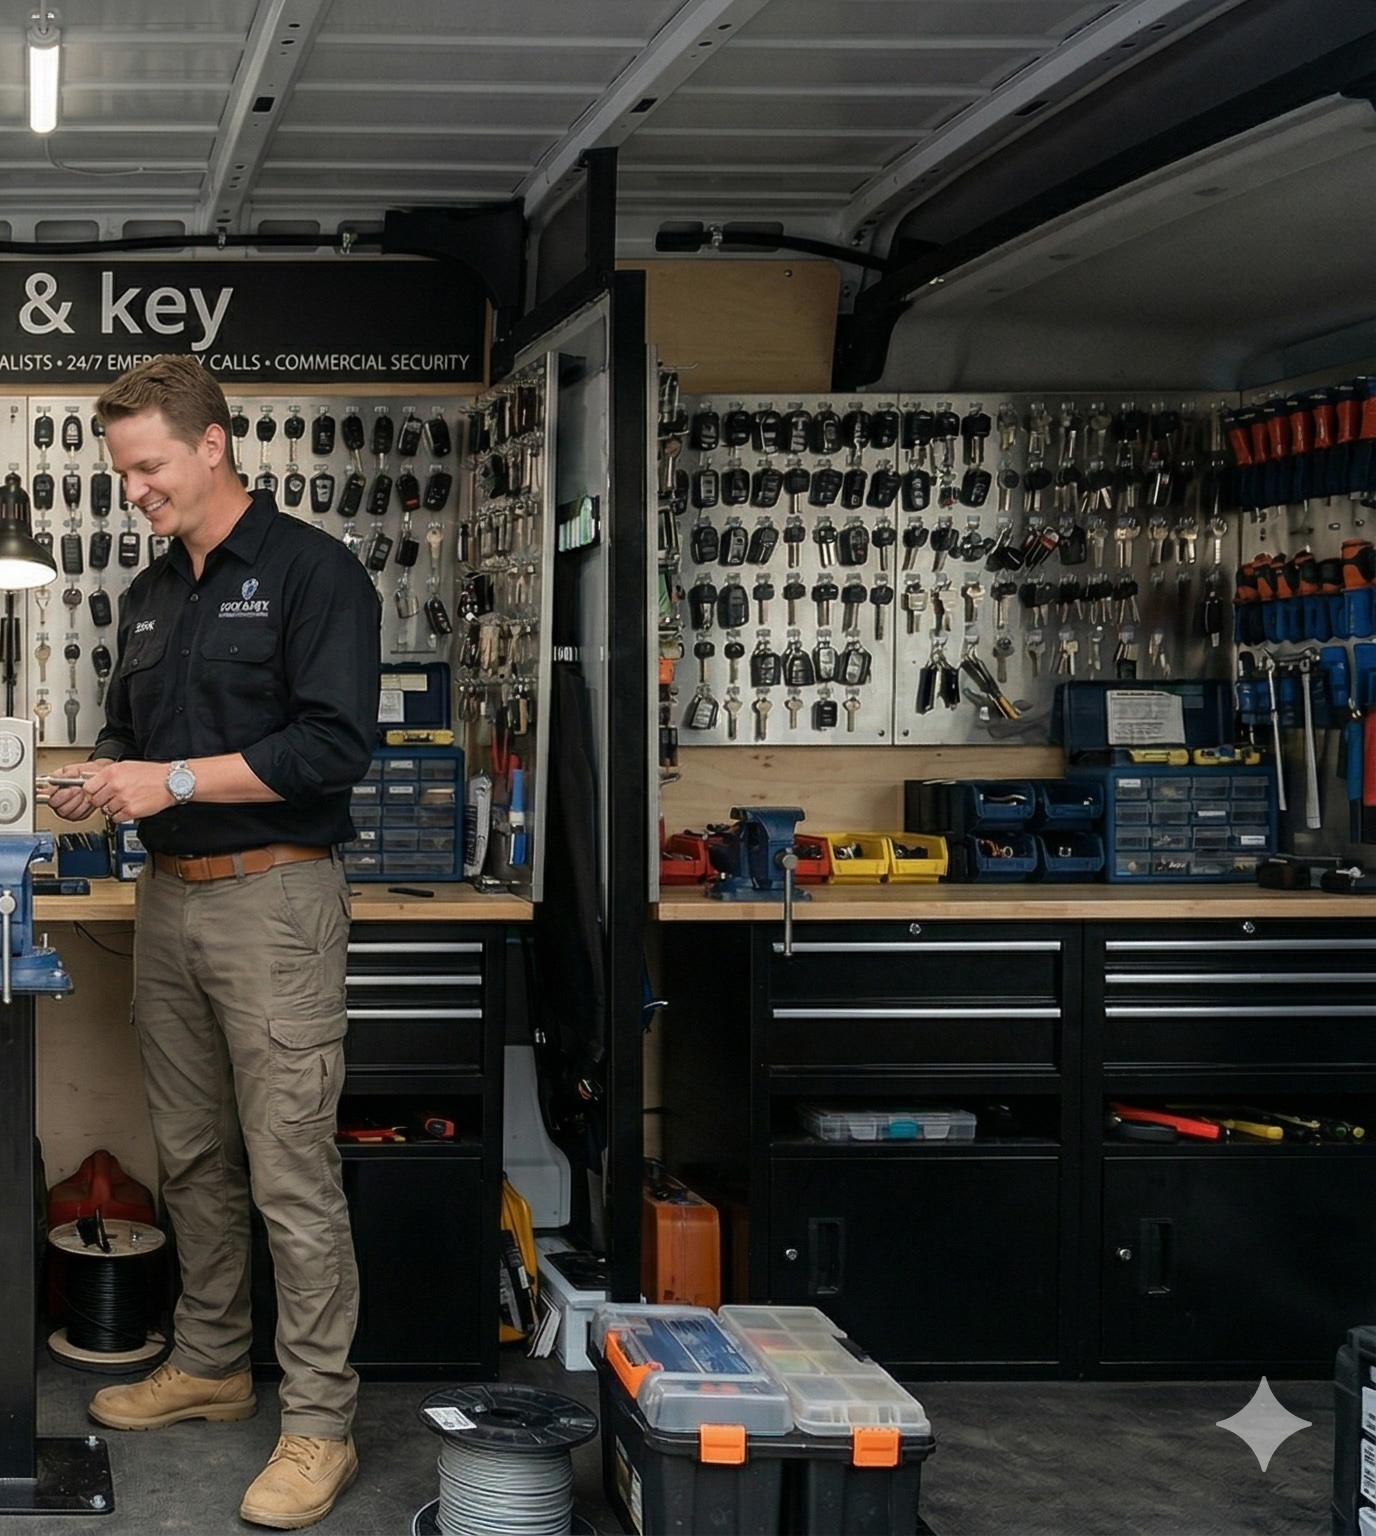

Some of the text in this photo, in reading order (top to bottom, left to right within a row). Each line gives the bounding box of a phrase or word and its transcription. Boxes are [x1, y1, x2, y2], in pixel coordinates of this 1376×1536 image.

[19, 272, 75, 335] &
[101, 271, 234, 351] key
[66, 354, 103, 371] 24/7
[210, 354, 261, 371] CALLS
[274, 354, 387, 371] COMMERCIAL
[390, 354, 470, 371] SECURITY
